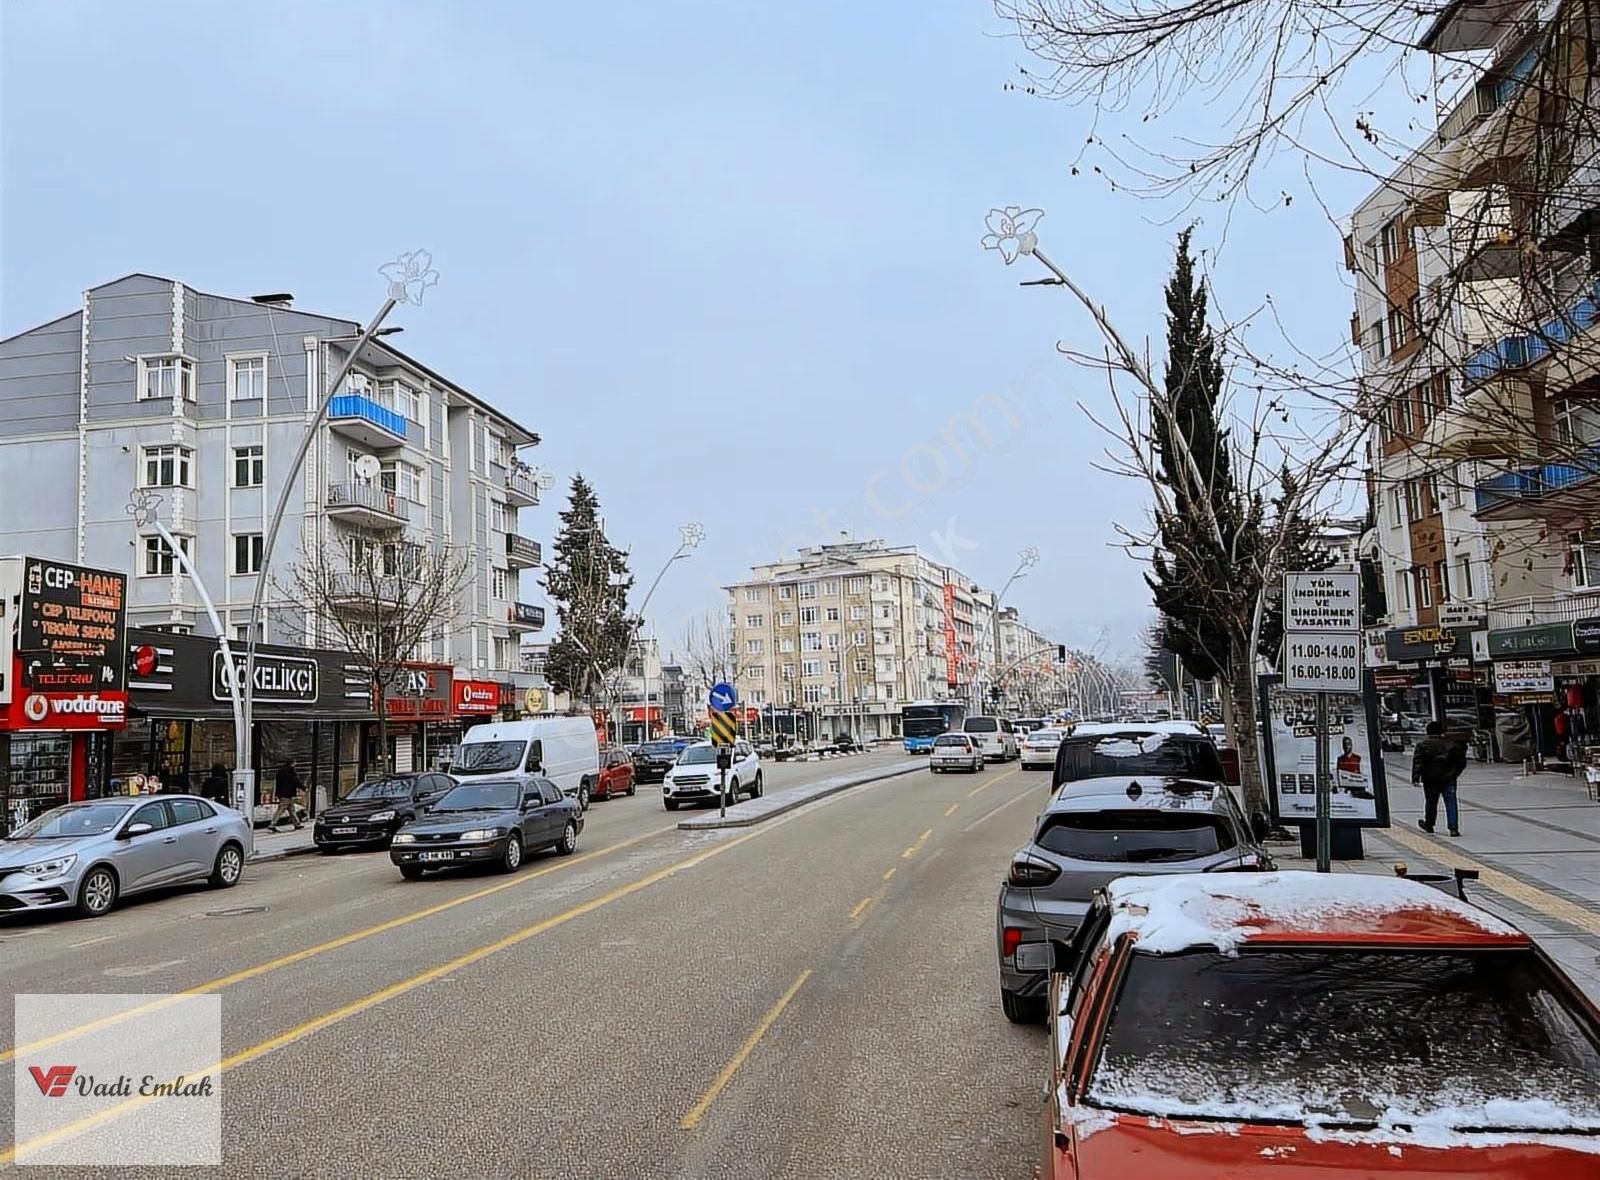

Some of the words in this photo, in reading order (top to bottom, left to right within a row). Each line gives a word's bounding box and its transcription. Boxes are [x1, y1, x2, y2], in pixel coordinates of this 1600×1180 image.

[1315, 599, 1330, 607] VE
[1294, 618, 1352, 627] YASAKTIR
[1290, 643, 1356, 659] 11.00-14.00
[1290, 664, 1356, 680] 16.00-18.00
[51, 693, 125, 715] vodafone
